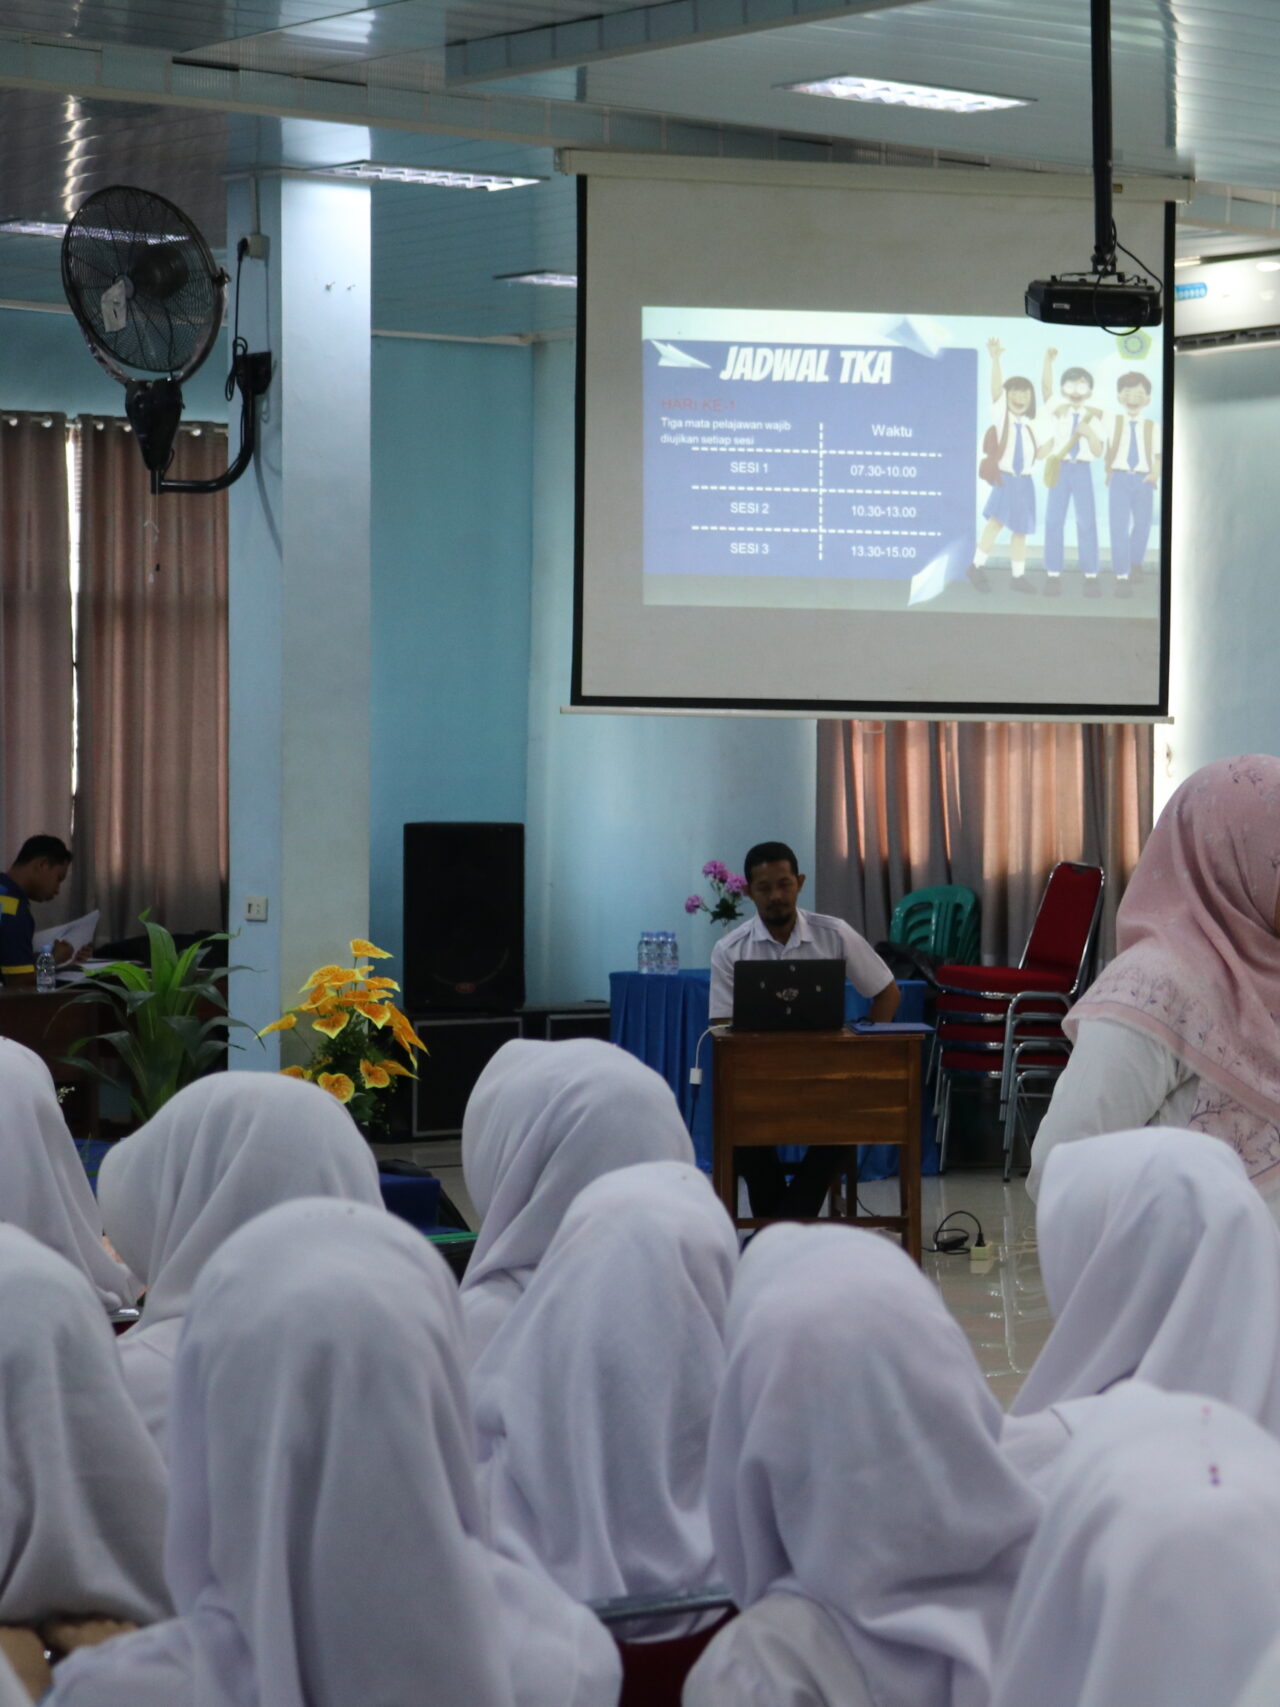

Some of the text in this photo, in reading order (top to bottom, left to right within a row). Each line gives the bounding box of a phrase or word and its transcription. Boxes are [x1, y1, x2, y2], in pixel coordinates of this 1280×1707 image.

[719, 346, 892, 384] JADWAL TKA
[661, 397, 697, 410] HARI
[660, 416, 683, 430] Tiga
[684, 419, 710, 429] mata
[765, 420, 792, 432] wajib
[871, 424, 913, 438] Waktu
[660, 433, 755, 446] diujikan setiap sesi
[730, 462, 769, 474] SESI 1
[850, 465, 917, 478] 07.30-10.00
[730, 502, 770, 514] SESI 2
[851, 505, 917, 518] 10.30-13.00
[730, 542, 770, 555] SESI 3
[851, 545, 917, 558] 13.30-15.00
